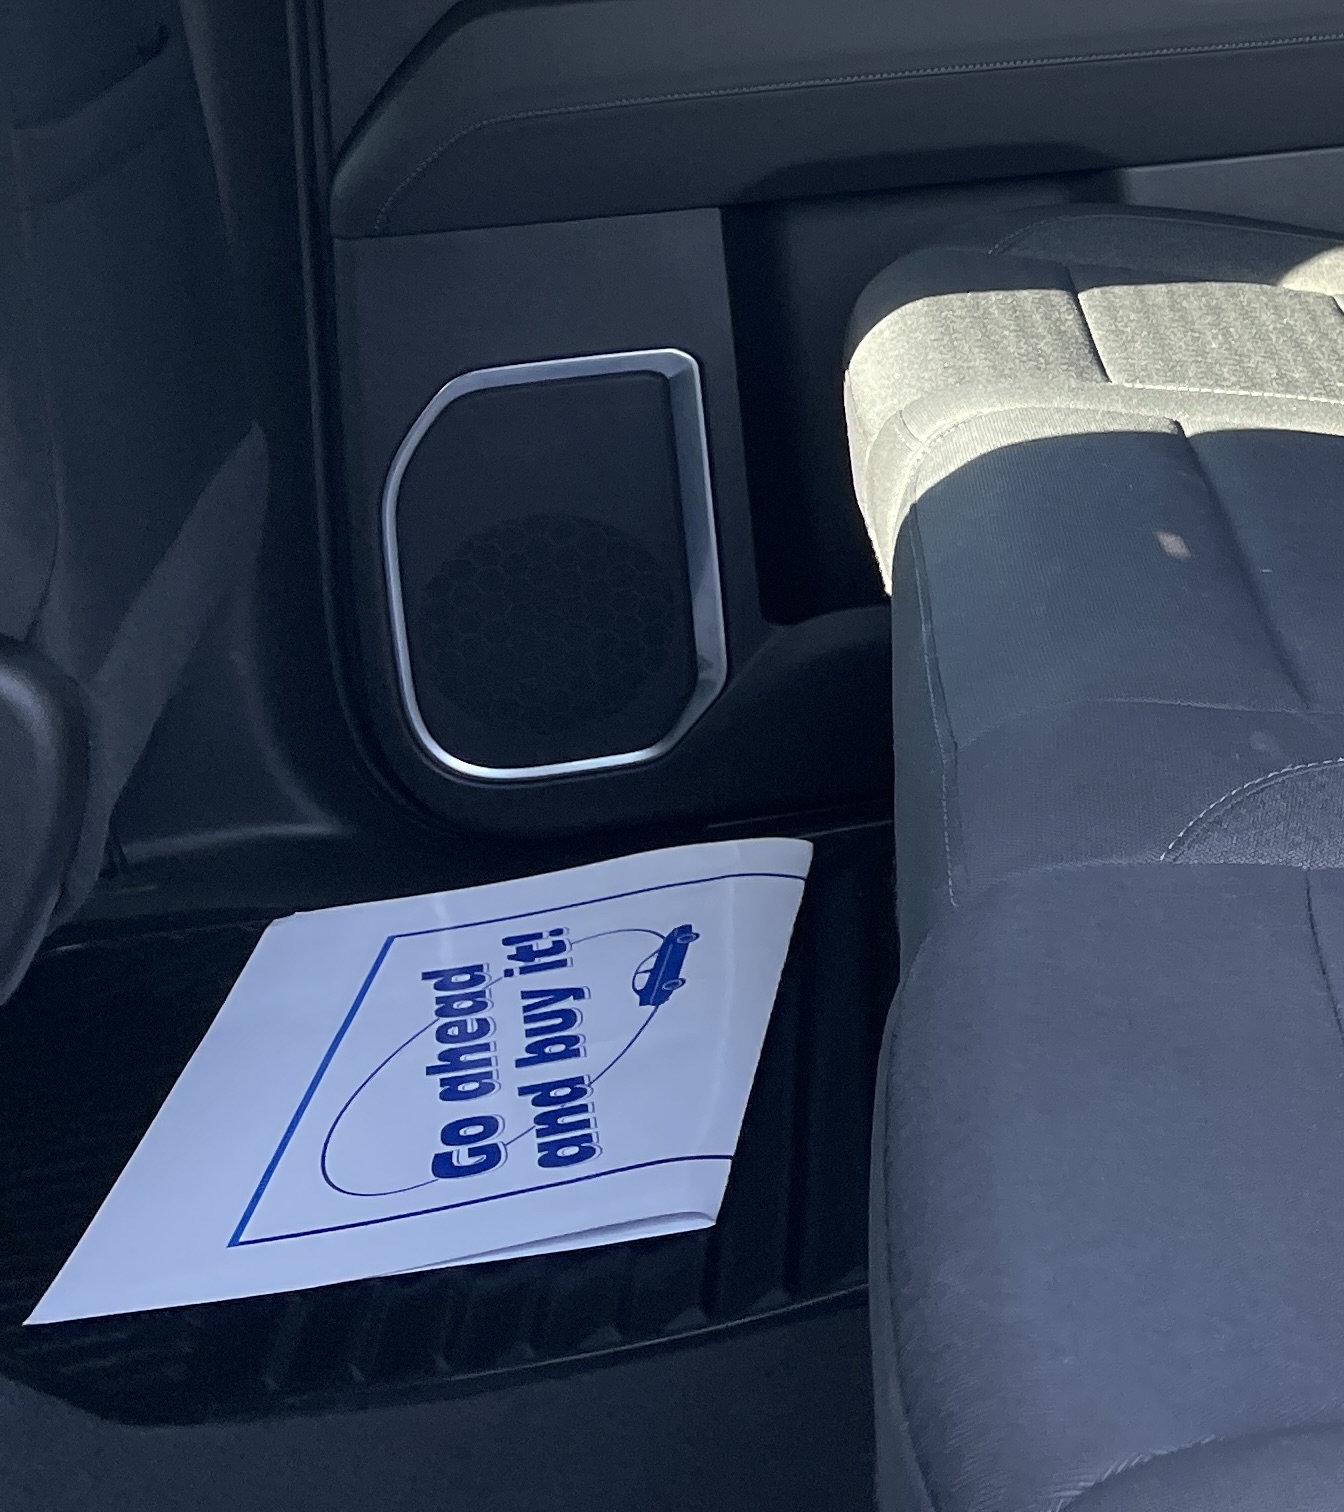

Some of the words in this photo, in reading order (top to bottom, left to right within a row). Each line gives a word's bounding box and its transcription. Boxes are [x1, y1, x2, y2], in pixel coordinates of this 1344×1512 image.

[501, 927, 574, 979] it!
[421, 963, 501, 1103] ahead
[514, 987, 592, 1071] buy
[431, 1114, 506, 1180] Go
[517, 1076, 603, 1171] and
